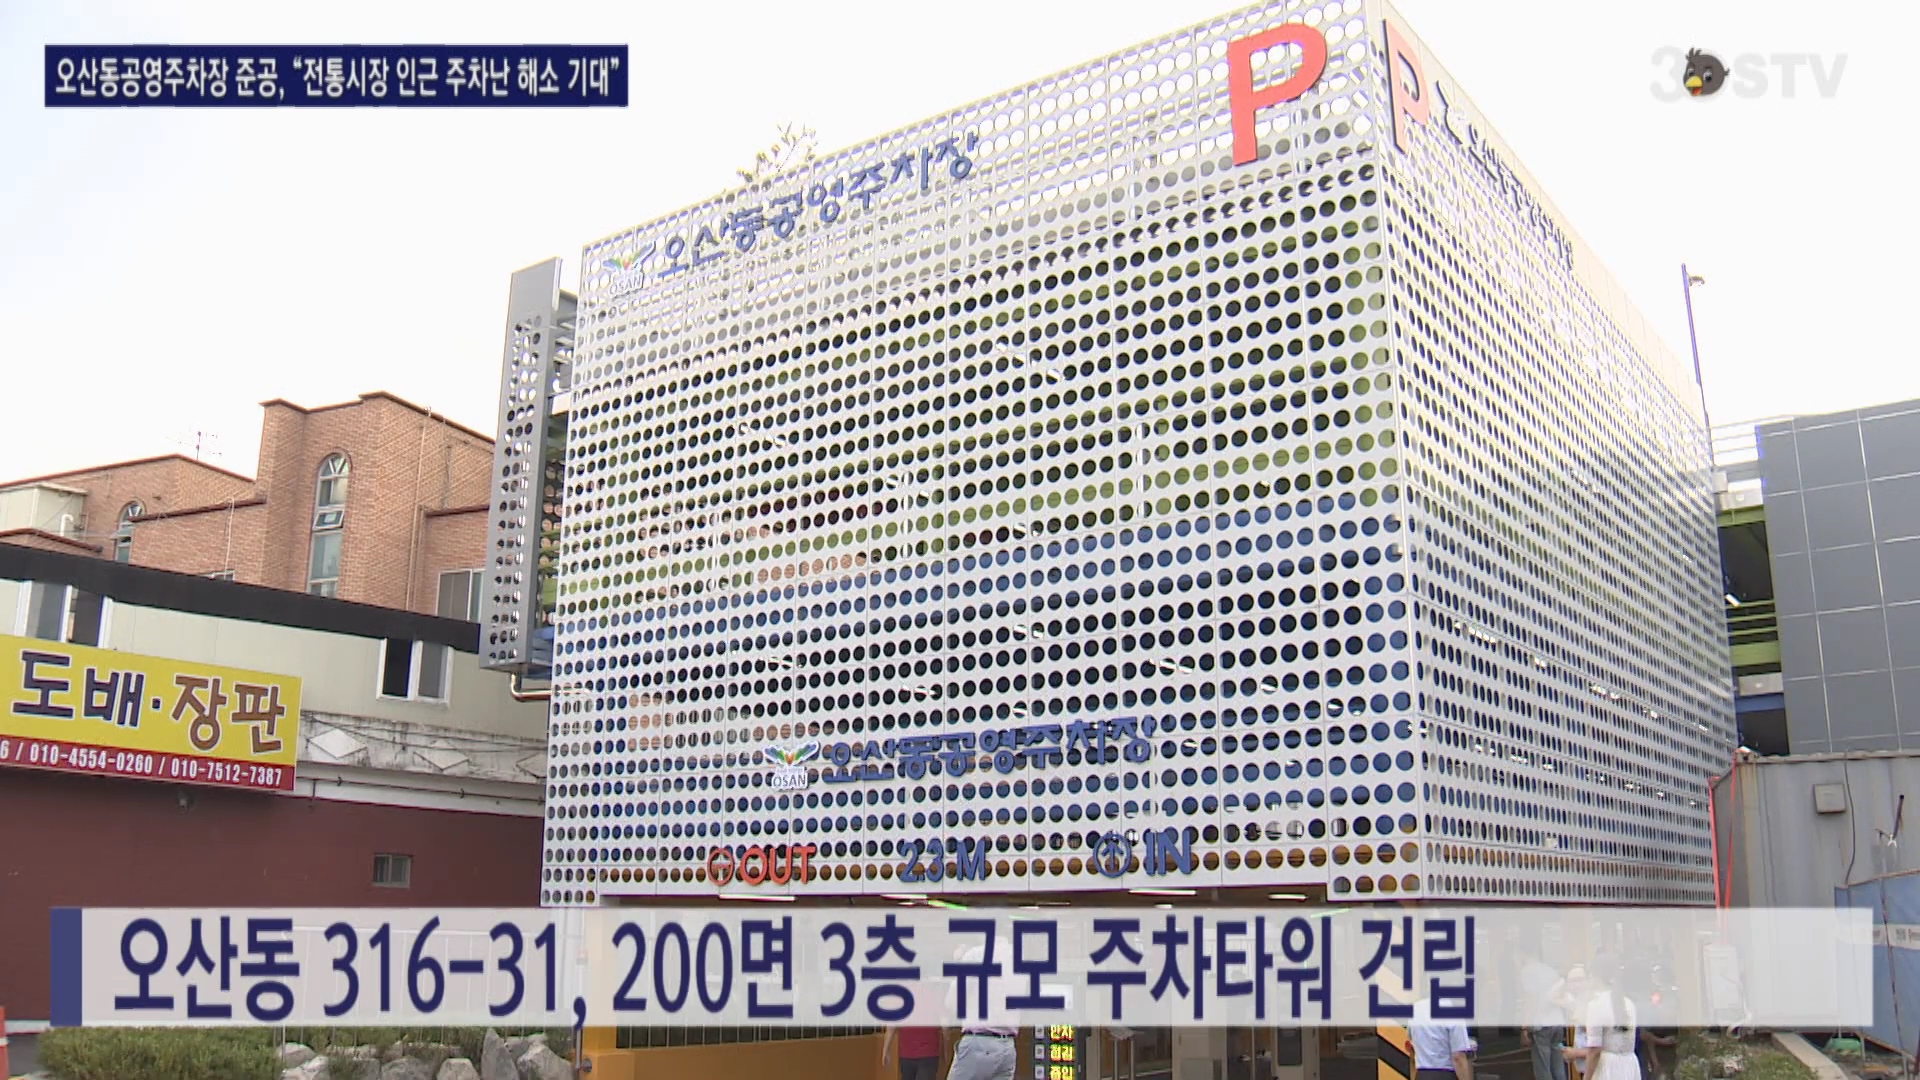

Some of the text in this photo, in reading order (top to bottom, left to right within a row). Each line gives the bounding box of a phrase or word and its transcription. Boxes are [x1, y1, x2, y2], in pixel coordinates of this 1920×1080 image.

[1227, 22, 1328, 167] P
[1382, 18, 1430, 155] P
[657, 131, 980, 279] 오산동공영주차장
[609, 274, 643, 296] OSAN
[30, 742, 153, 775] 010-4554-0260
[170, 760, 283, 787] 010-7512-7387
[822, 715, 1154, 784] 오산동공영주차장
[772, 773, 807, 789] OSAN
[739, 845, 817, 886] OUT
[1145, 829, 1192, 876] IN
